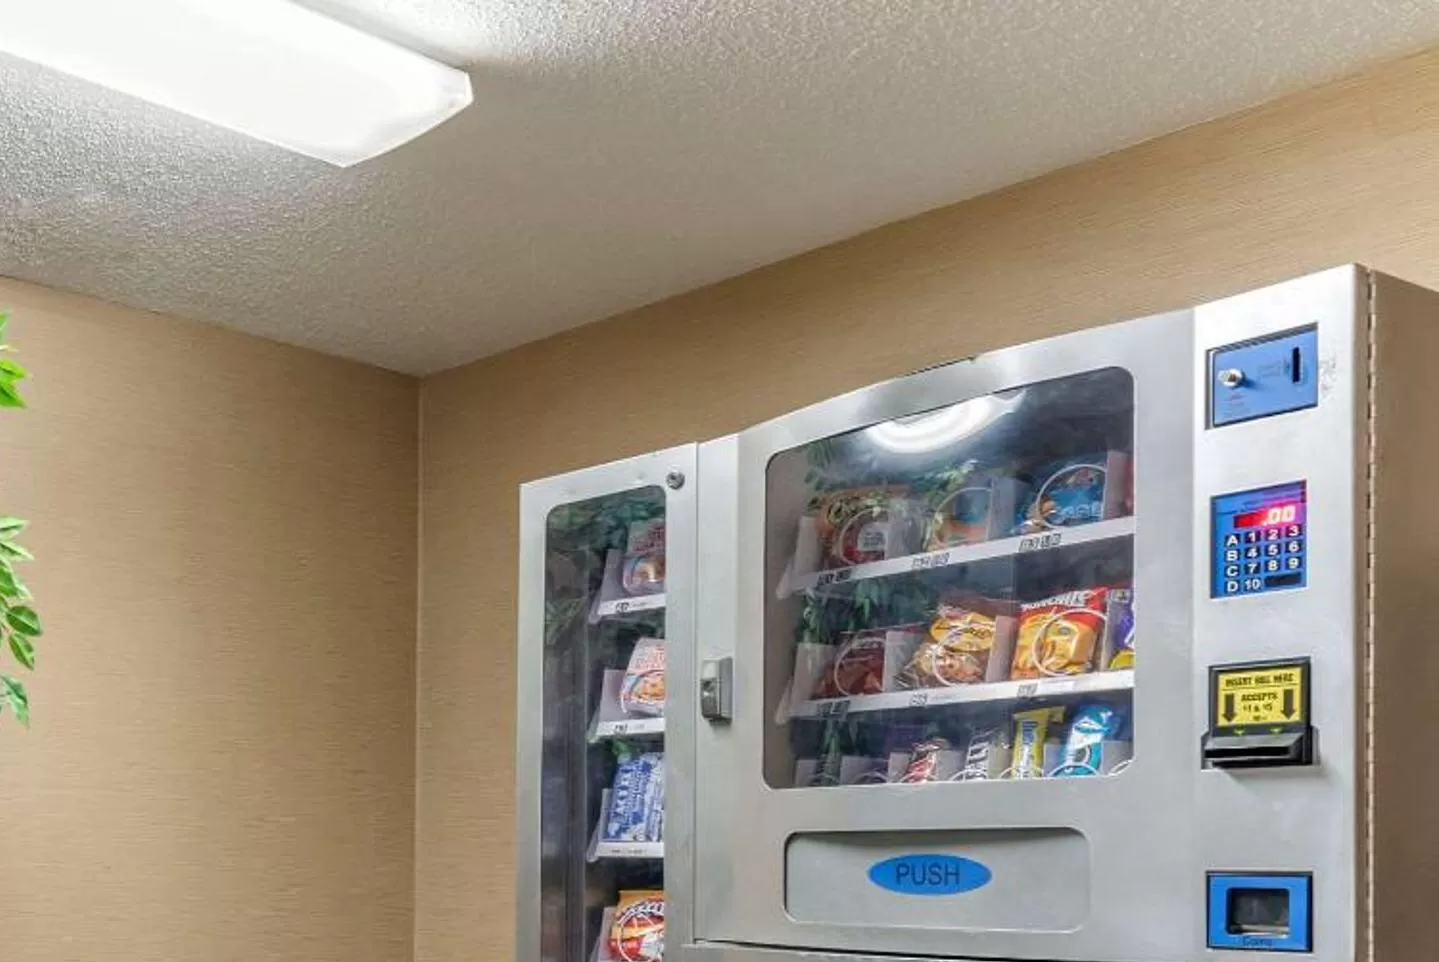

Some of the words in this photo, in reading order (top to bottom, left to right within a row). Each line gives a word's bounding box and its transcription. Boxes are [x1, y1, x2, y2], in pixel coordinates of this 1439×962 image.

[1226, 535, 1238, 547] A
[1248, 532, 1257, 542] 1
[1268, 529, 1279, 540] 2
[1289, 525, 1299, 536] 3
[1226, 550, 1238, 561] B
[1247, 548, 1258, 558] 4
[1268, 545, 1278, 555] 5
[1288, 541, 1299, 551] 6
[1226, 566, 1238, 577] C
[1247, 564, 1258, 573] 7
[1268, 560, 1278, 571] 8
[1288, 558, 1298, 569] 9
[1227, 582, 1238, 592] D
[1245, 579, 1261, 590] 10
[895, 862, 960, 886] PUSH
